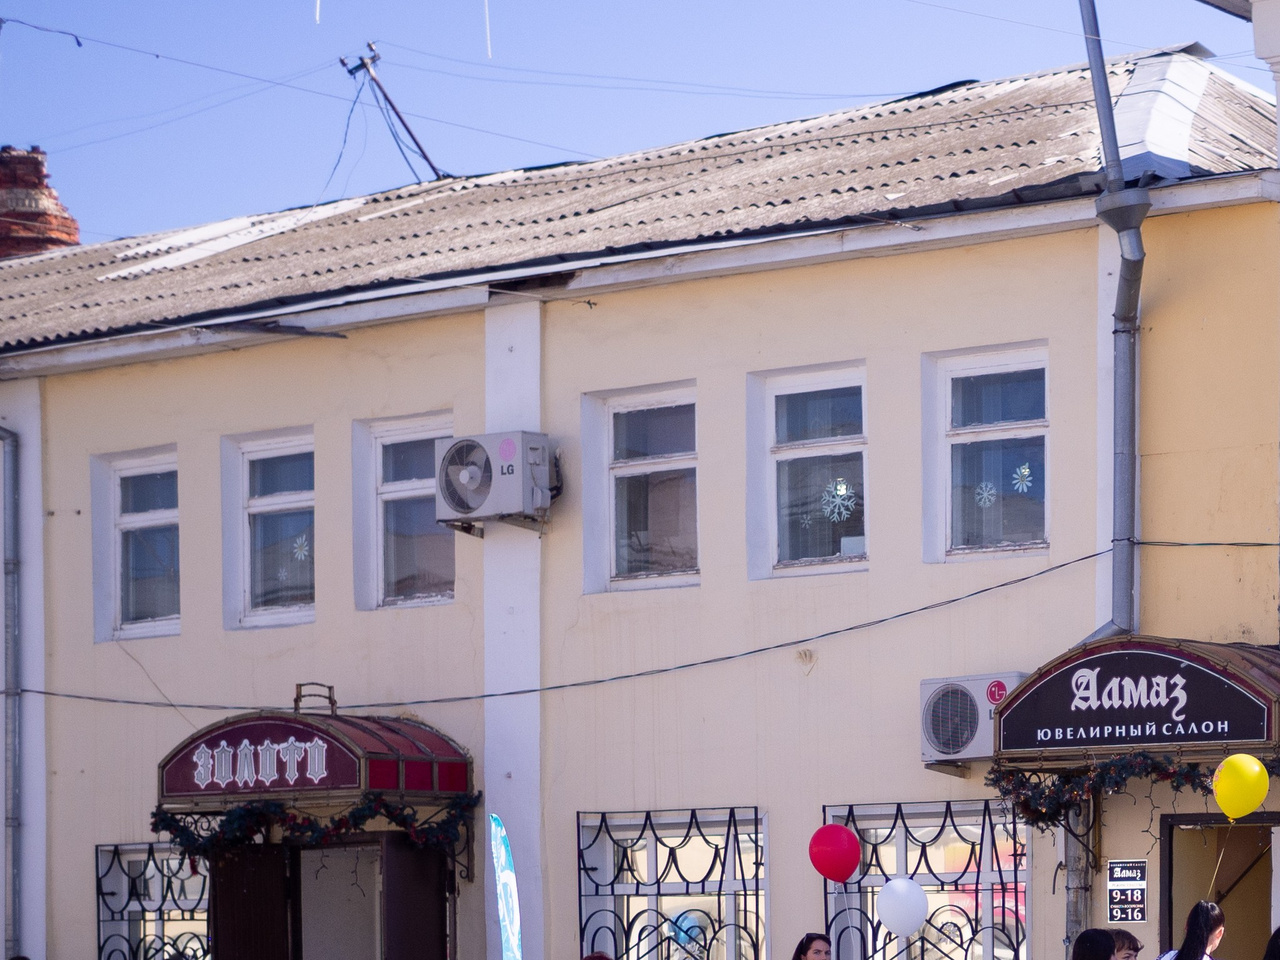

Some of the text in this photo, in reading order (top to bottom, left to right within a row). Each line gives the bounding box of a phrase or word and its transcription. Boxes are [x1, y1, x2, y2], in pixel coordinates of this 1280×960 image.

[501, 464, 515, 476] LG
[1071, 667, 1188, 721] Алмаз
[1037, 720, 1229, 741] ЮВЕЛИРНЫЙ САЛОН
[193, 736, 328, 789] ЗОЛОТО
[1112, 889, 1142, 902] 9-18
[1112, 908, 1142, 920] 9-16
